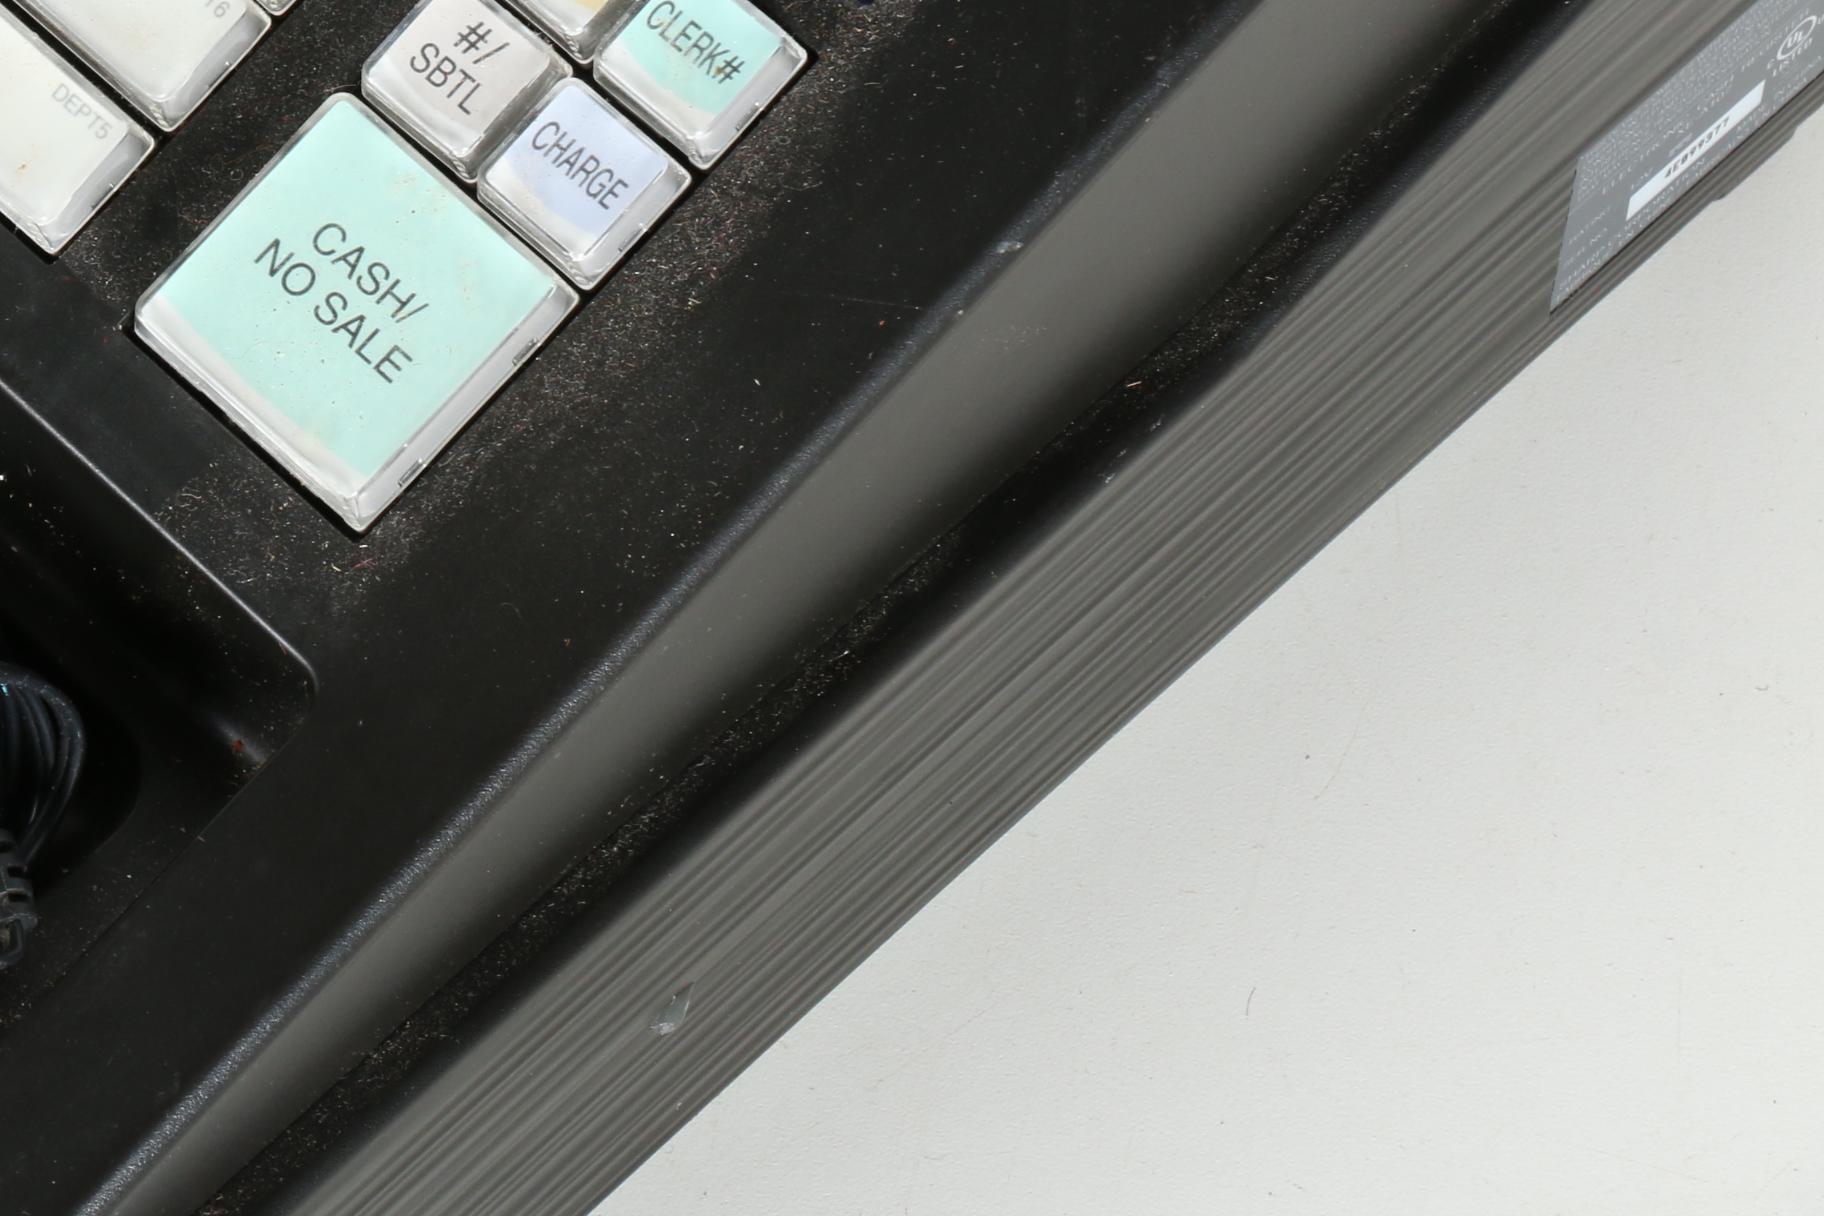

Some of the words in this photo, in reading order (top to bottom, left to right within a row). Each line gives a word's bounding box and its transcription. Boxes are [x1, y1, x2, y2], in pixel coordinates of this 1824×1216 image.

[408, 42, 491, 117] SBTL
[454, 19, 510, 66] #/
[51, 81, 112, 141] DEPT5
[530, 120, 630, 212] CHARGE
[253, 236, 318, 299] NO
[313, 290, 415, 385] SALE
[310, 221, 431, 324] CASH/
